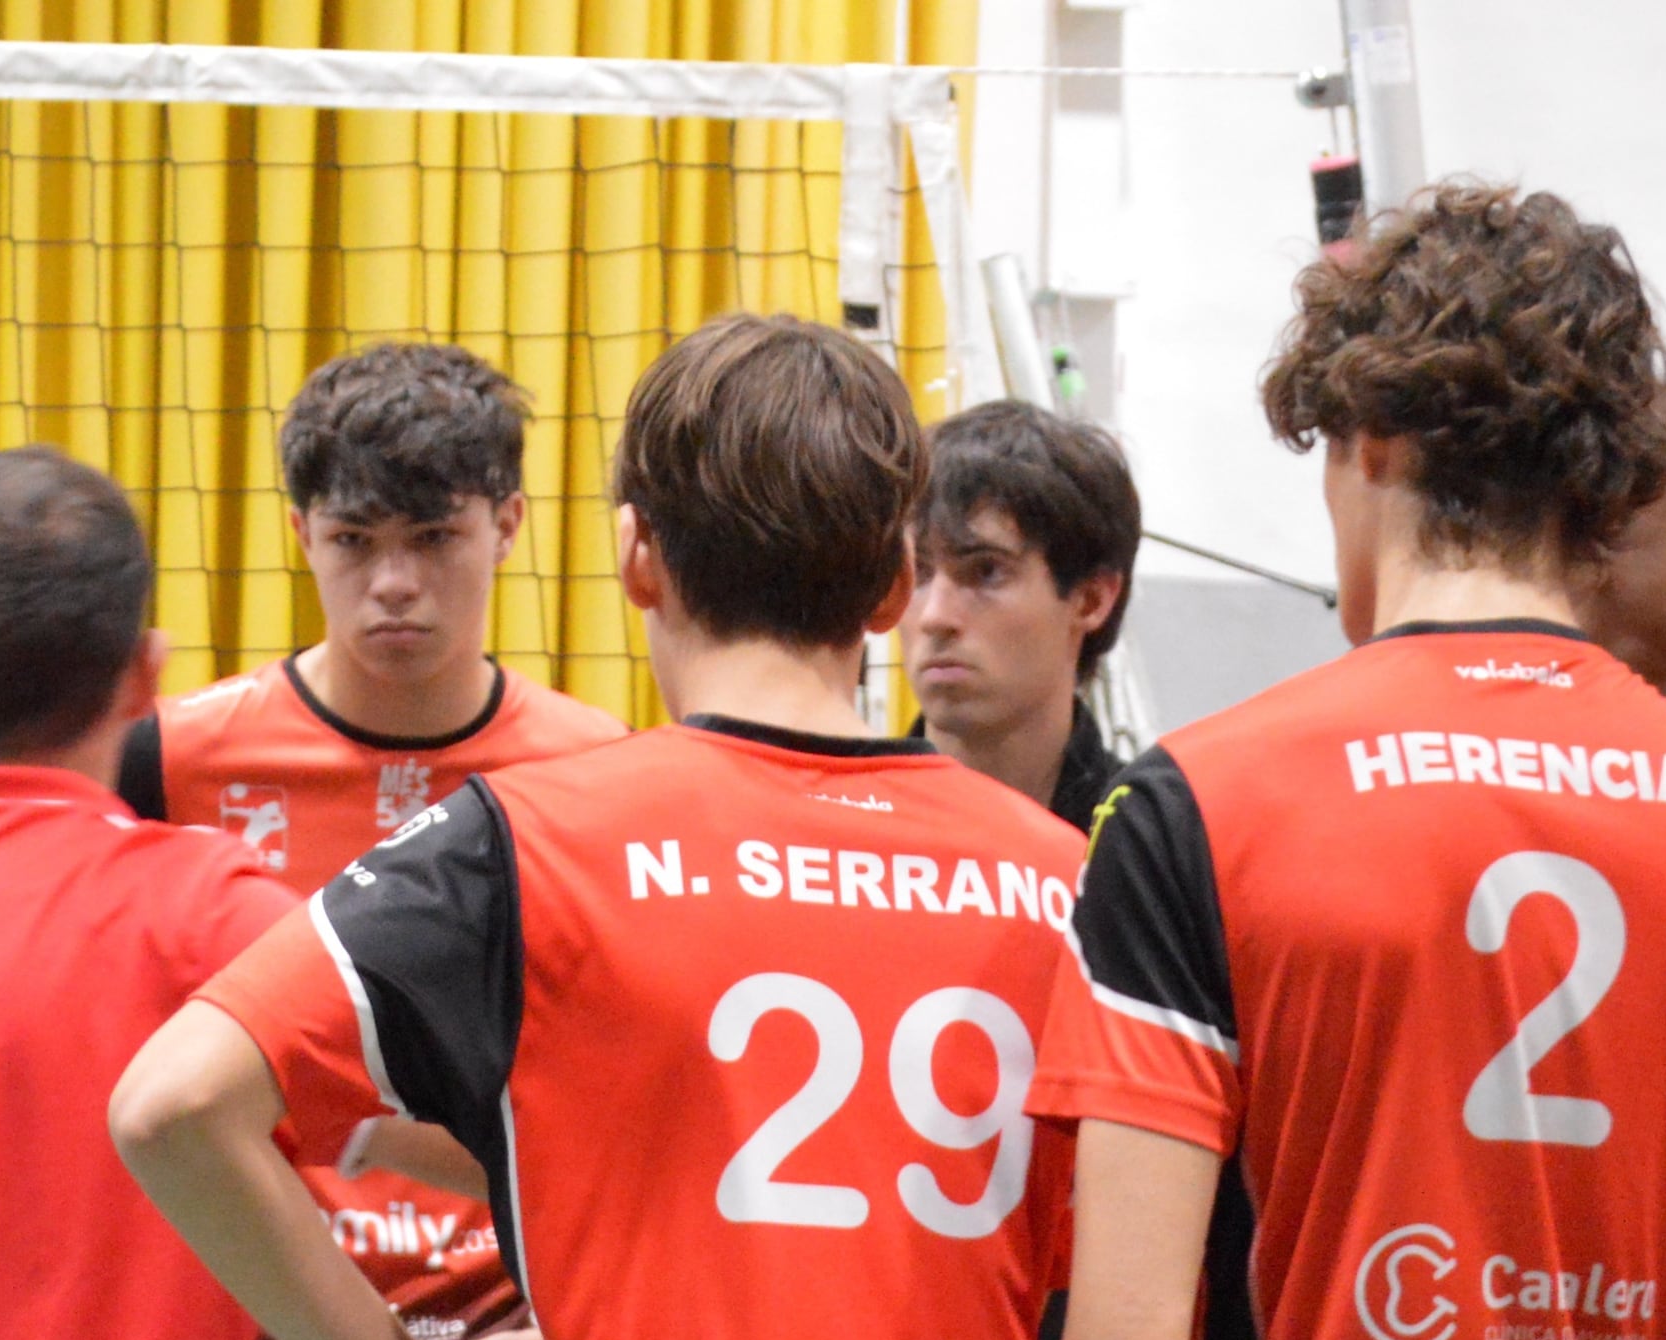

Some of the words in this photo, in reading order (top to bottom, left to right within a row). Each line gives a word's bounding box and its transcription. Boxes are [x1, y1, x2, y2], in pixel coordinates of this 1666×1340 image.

[626, 839, 710, 900] N.
[735, 839, 1073, 932] SERRANO
[1463, 850, 1627, 1147] 2
[707, 971, 1036, 1240] 29
